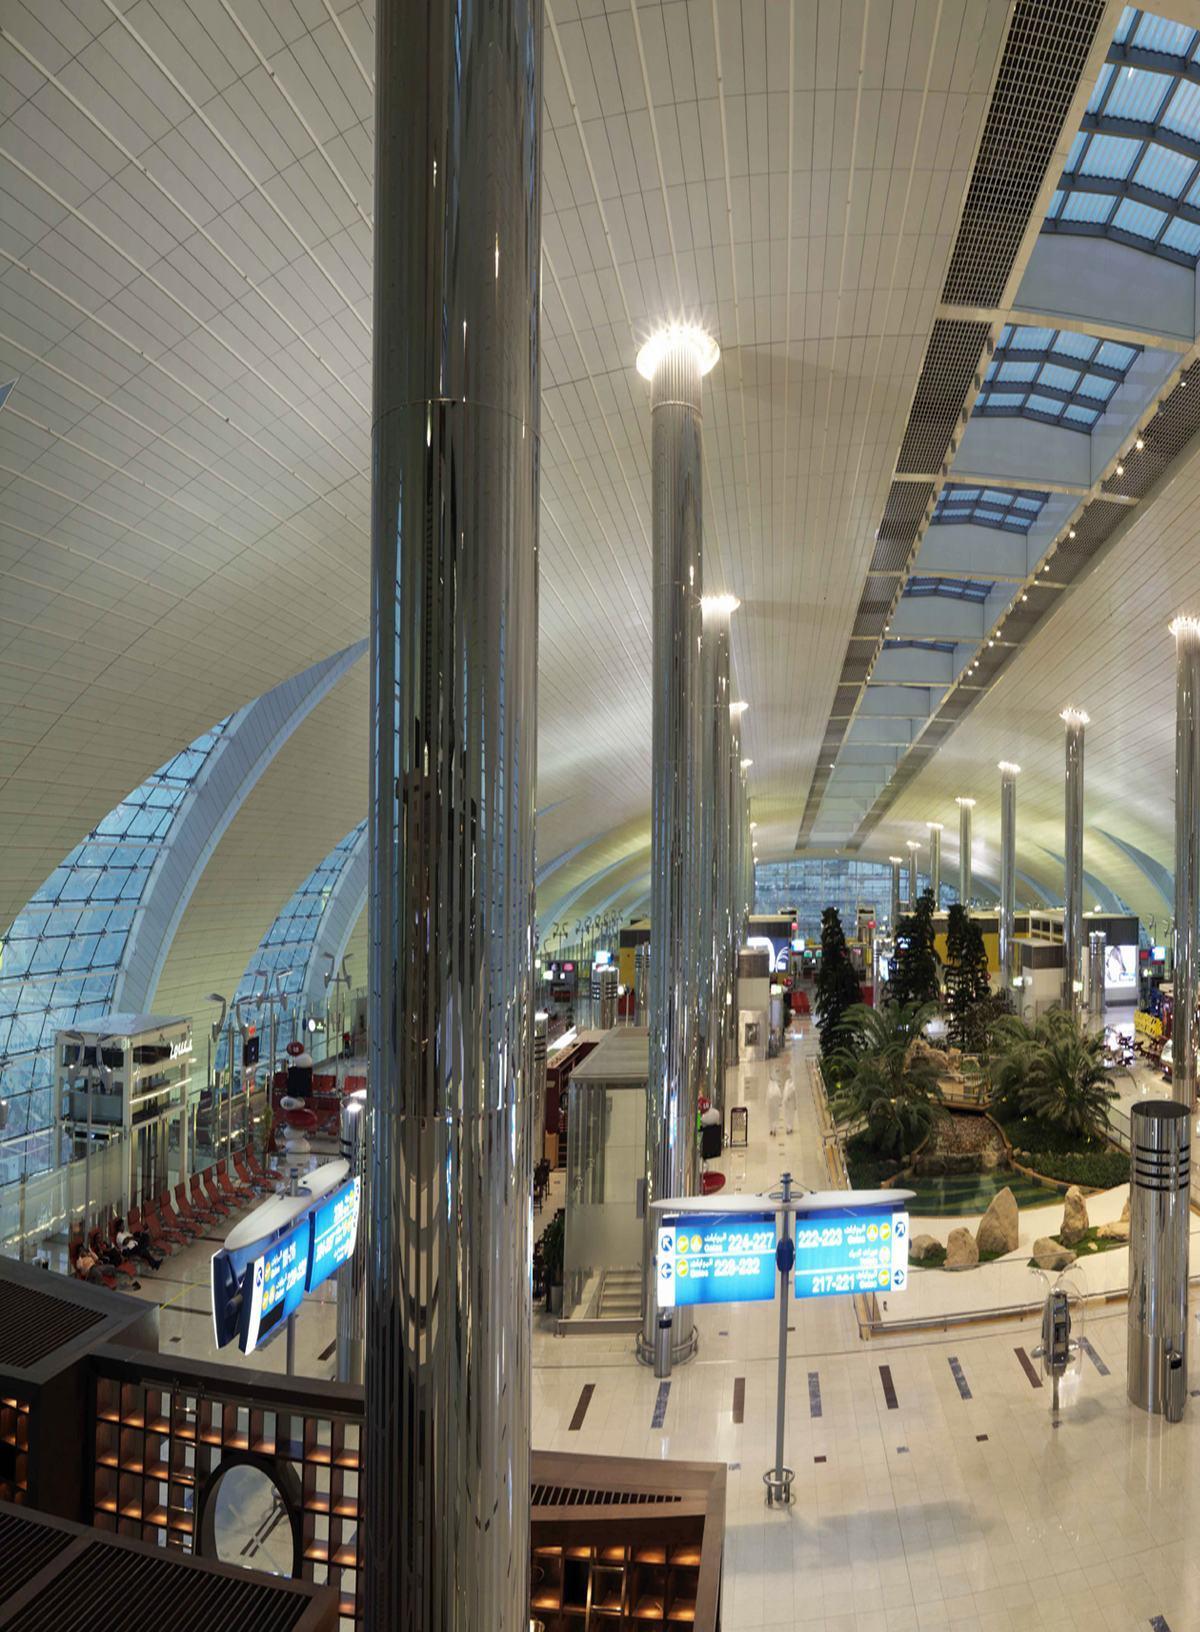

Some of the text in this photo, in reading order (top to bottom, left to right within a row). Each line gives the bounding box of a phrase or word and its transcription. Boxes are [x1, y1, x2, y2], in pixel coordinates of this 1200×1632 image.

[728, 1232, 774, 1251] 224-227
[798, 1227, 843, 1248] 222-223
[812, 1273, 854, 1293] 217-221
